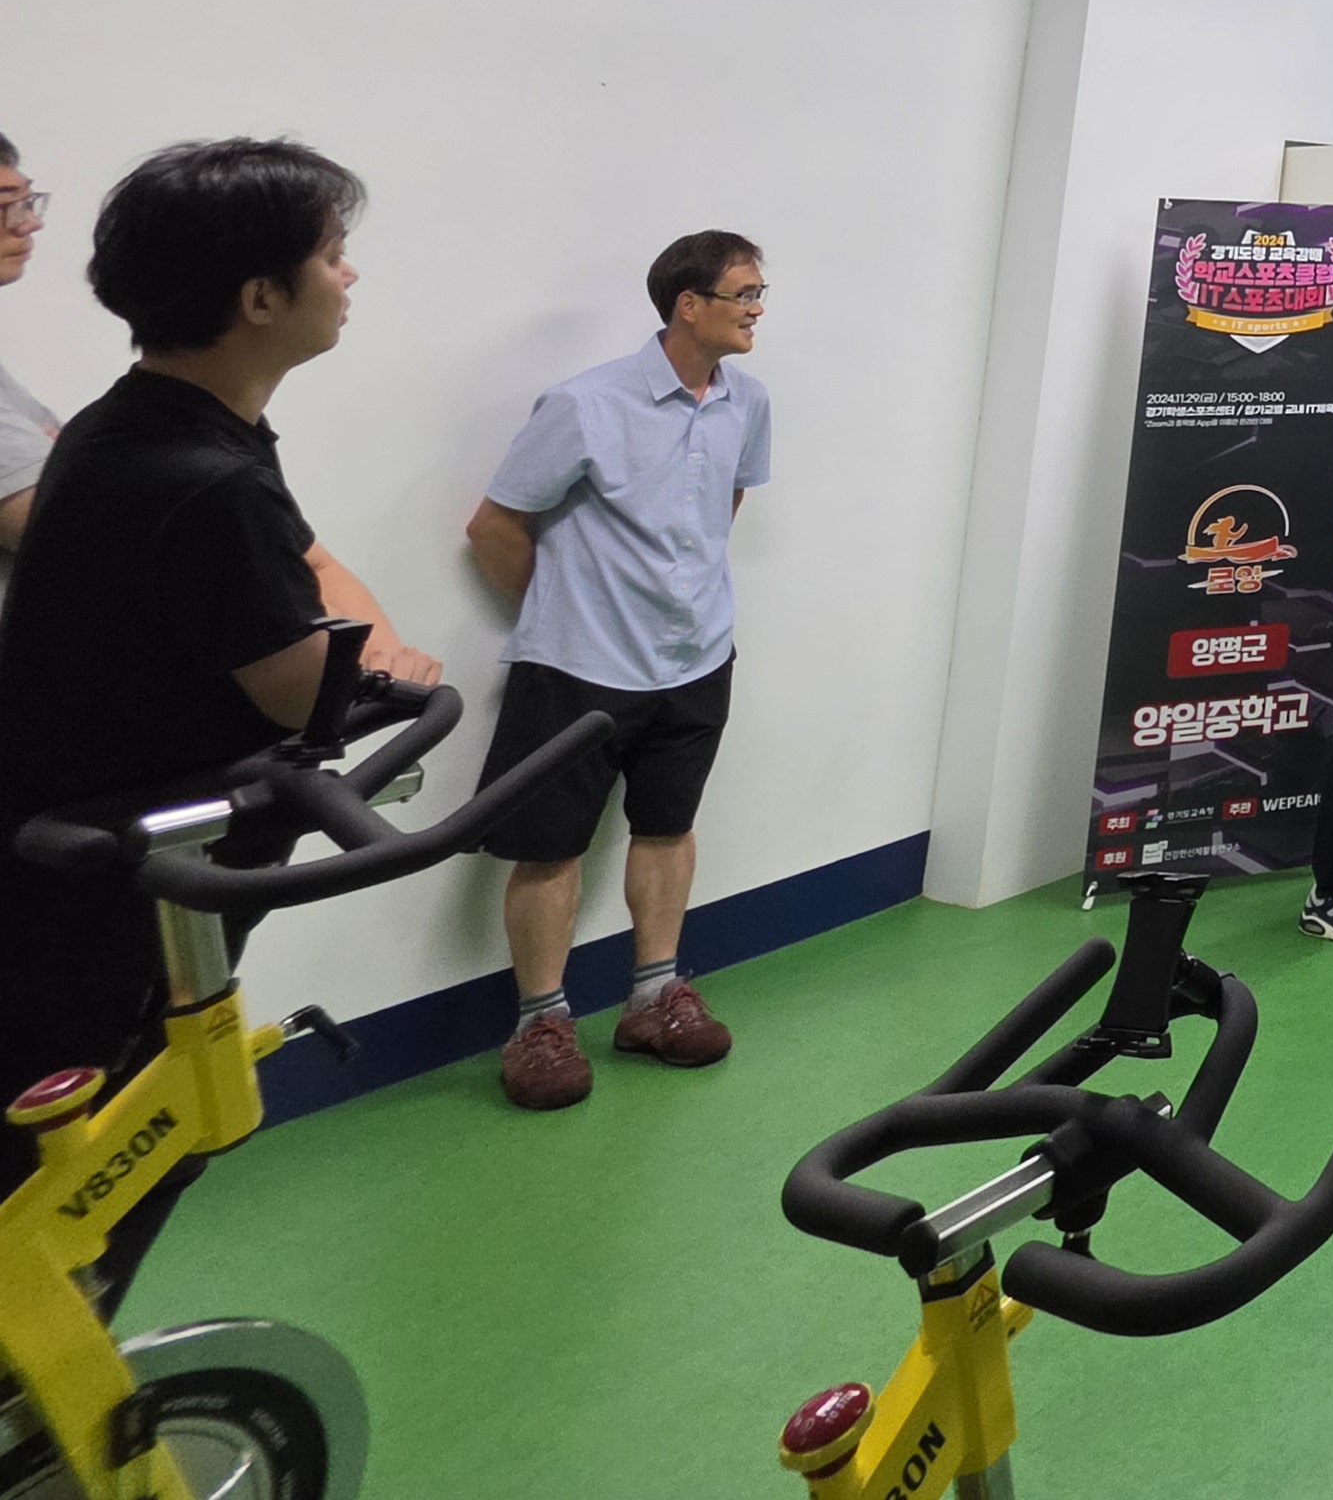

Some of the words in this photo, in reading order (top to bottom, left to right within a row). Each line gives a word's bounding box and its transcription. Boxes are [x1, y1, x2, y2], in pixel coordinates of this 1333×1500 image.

[1253, 235, 1286, 246] 2024
[1268, 246, 1323, 262] 교육감배
[1200, 284, 1326, 312] IT스포츠대회
[1231, 321, 1245, 331] IT
[1247, 319, 1289, 333] sports
[1191, 634, 1268, 668] 양평군
[1132, 692, 1310, 748] 양일중학교
